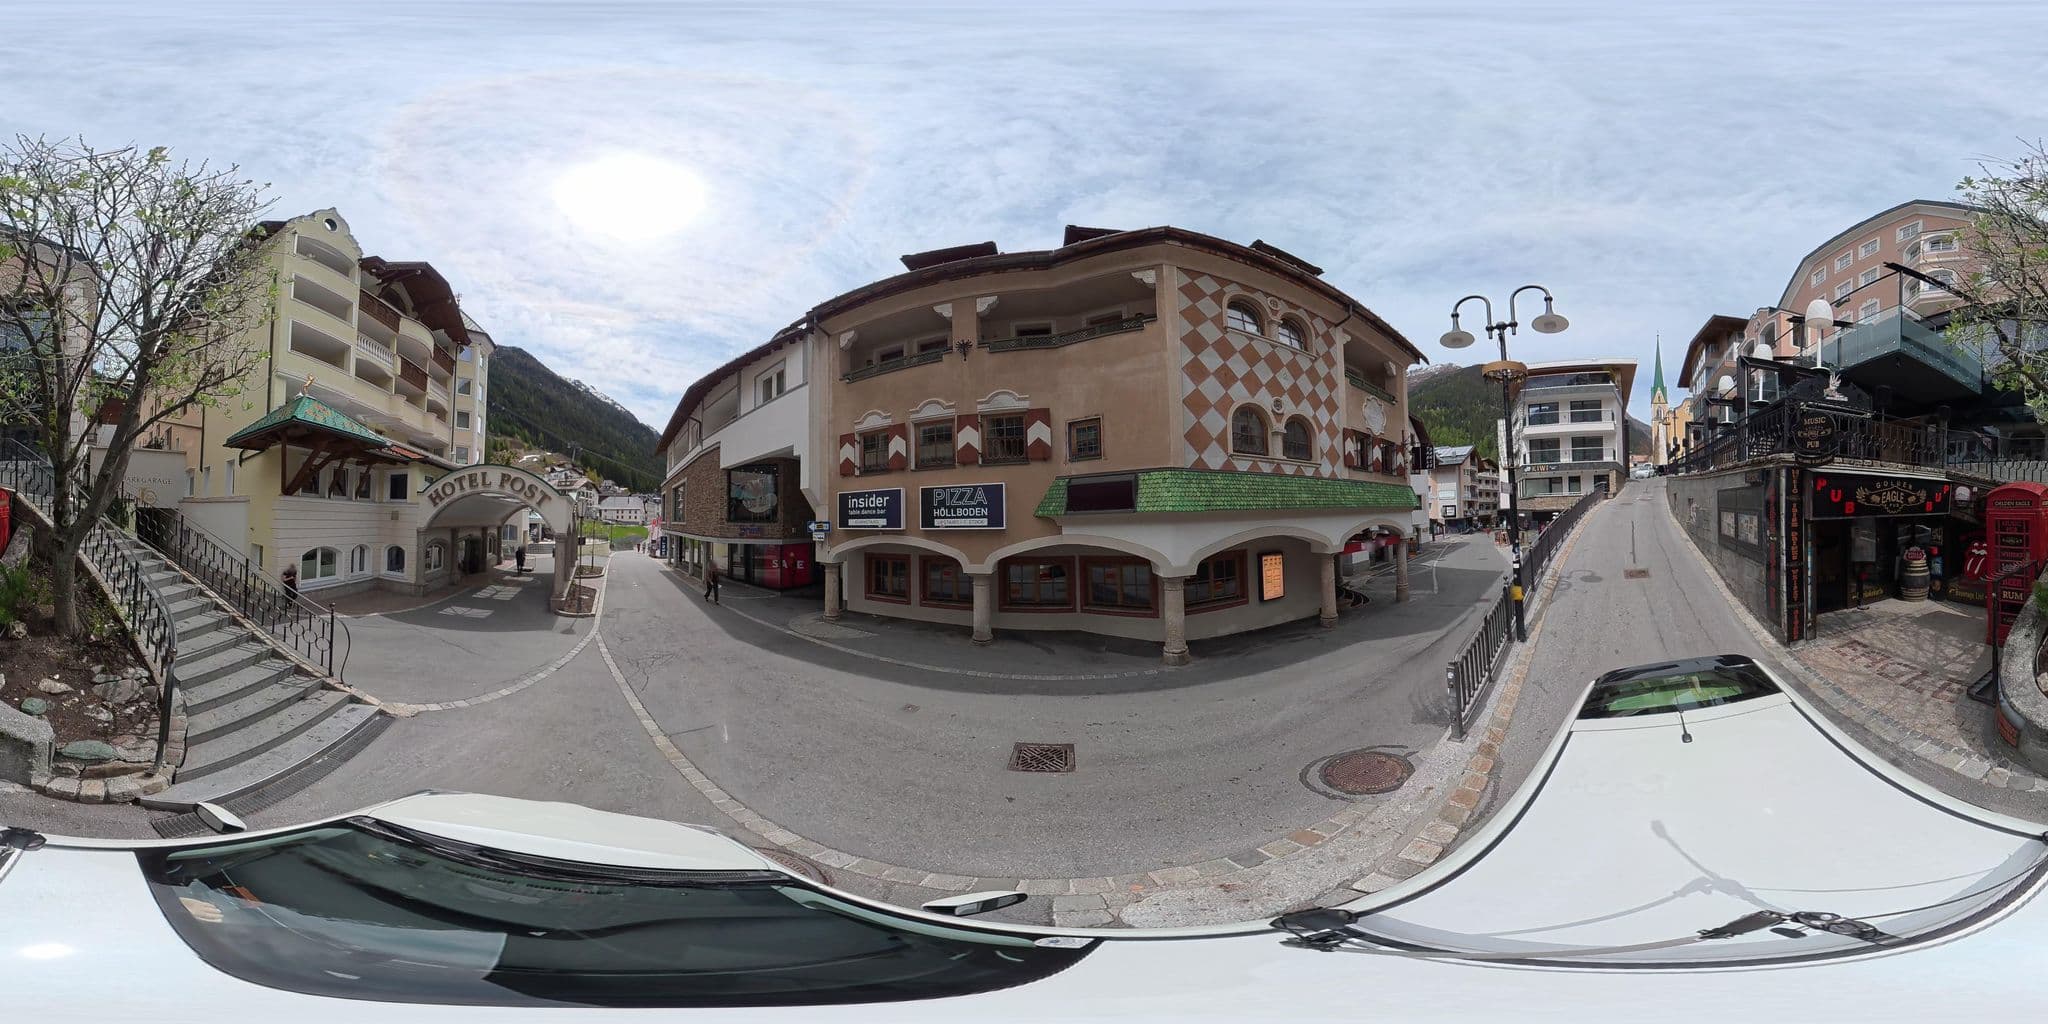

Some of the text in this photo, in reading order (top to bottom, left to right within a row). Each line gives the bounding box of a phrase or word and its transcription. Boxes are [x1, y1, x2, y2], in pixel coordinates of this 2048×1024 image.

[1804, 417, 1826, 425] MUSIC
[126, 475, 173, 486] ARKGARAGE
[1875, 481, 1913, 490] GOLDEN
[427, 472, 552, 507] HOTEL POST
[848, 494, 890, 508] insider
[933, 487, 988, 506] PIZZA
[1816, 477, 1855, 514] PUB
[1881, 490, 1905, 504] EAGLE
[933, 507, 988, 517] HÖLLBODEN
[772, 560, 804, 569] SAE
[2002, 590, 2023, 600] RUM
